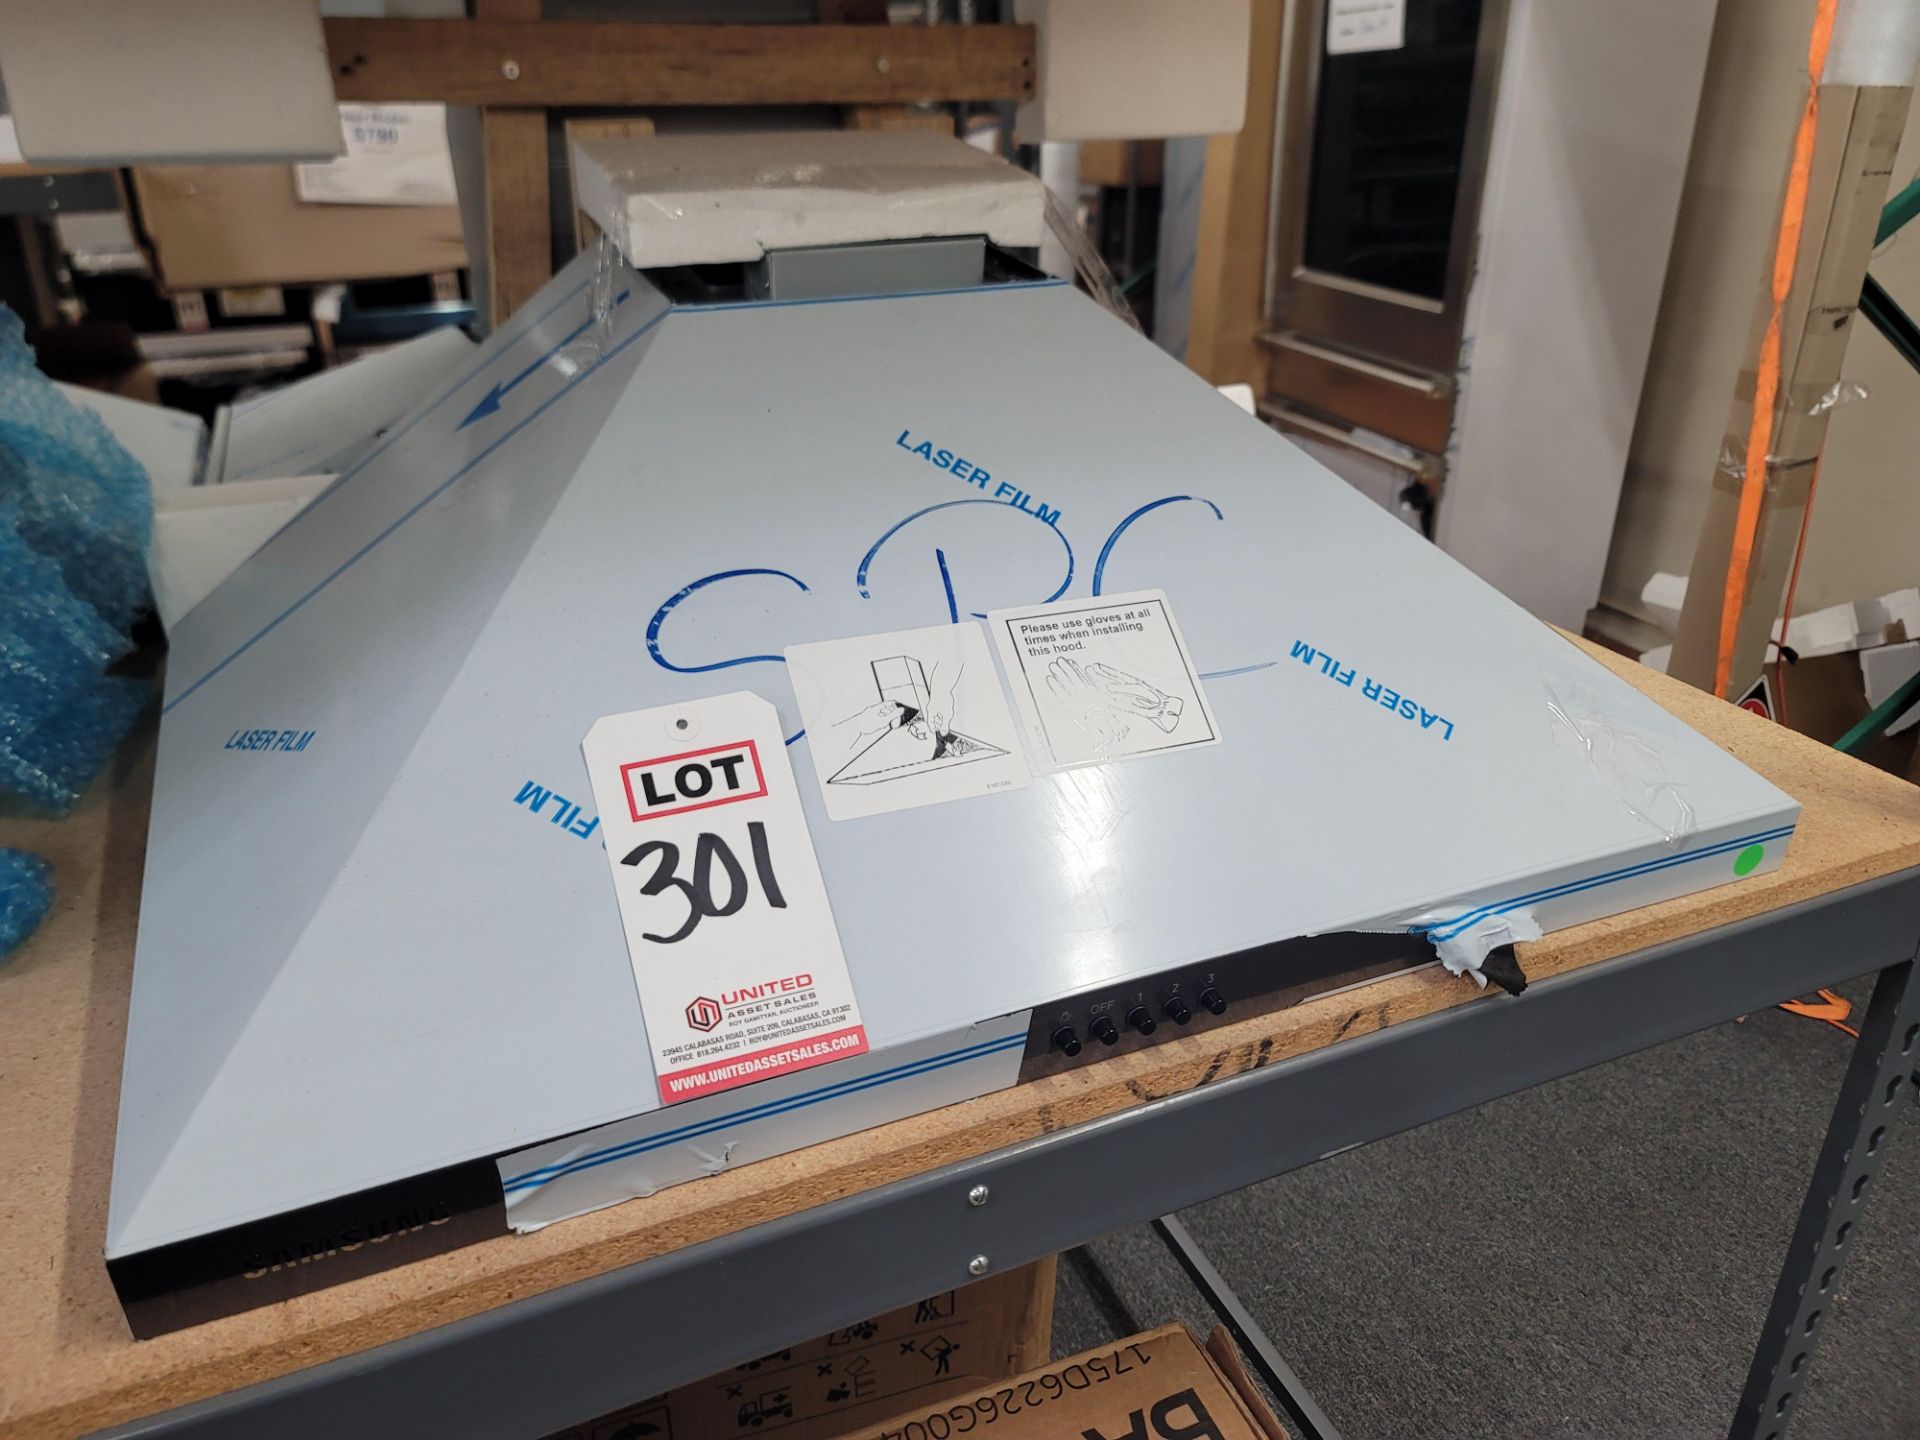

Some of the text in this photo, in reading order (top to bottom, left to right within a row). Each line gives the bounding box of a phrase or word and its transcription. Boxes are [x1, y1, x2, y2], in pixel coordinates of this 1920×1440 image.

[896, 429, 1061, 526] LASER FILM
[1020, 608, 1150, 635] Please use gloves at all
[1024, 621, 1144, 645] times when installing
[1028, 641, 1087, 657] this hood.
[1290, 640, 1454, 741] LASER FILM
[224, 730, 316, 752] LASER FILM
[640, 754, 744, 806] LOT
[513, 780, 600, 839] FILM
[620, 821, 787, 944] 301
[721, 973, 813, 1006] UNITED
[727, 992, 817, 1019] ASSET SALES
[728, 1019, 743, 1027] ROY
[779, 1000, 819, 1016] AUCTIONEER
[1090, 973, 1216, 1015] OFF 1 2 3
[662, 1045, 684, 1057] 23945
[684, 1032, 725, 1051] CALABASAS
[725, 1030, 744, 1042] ROAD,
[746, 1023, 766, 1037] SUITE
[780, 1009, 820, 1027] CALABASAS,
[821, 1007, 833, 1018] CA
[831, 1003, 851, 1015] 91302
[670, 1014, 847, 1065] OFFICE 818.264.4232 ROY@UNITEDASSETSALES.COM
[669, 1033, 860, 1092] WWW.UNITEDASSETSALES.COM
[243, 1202, 450, 1279] SAMSUNG
